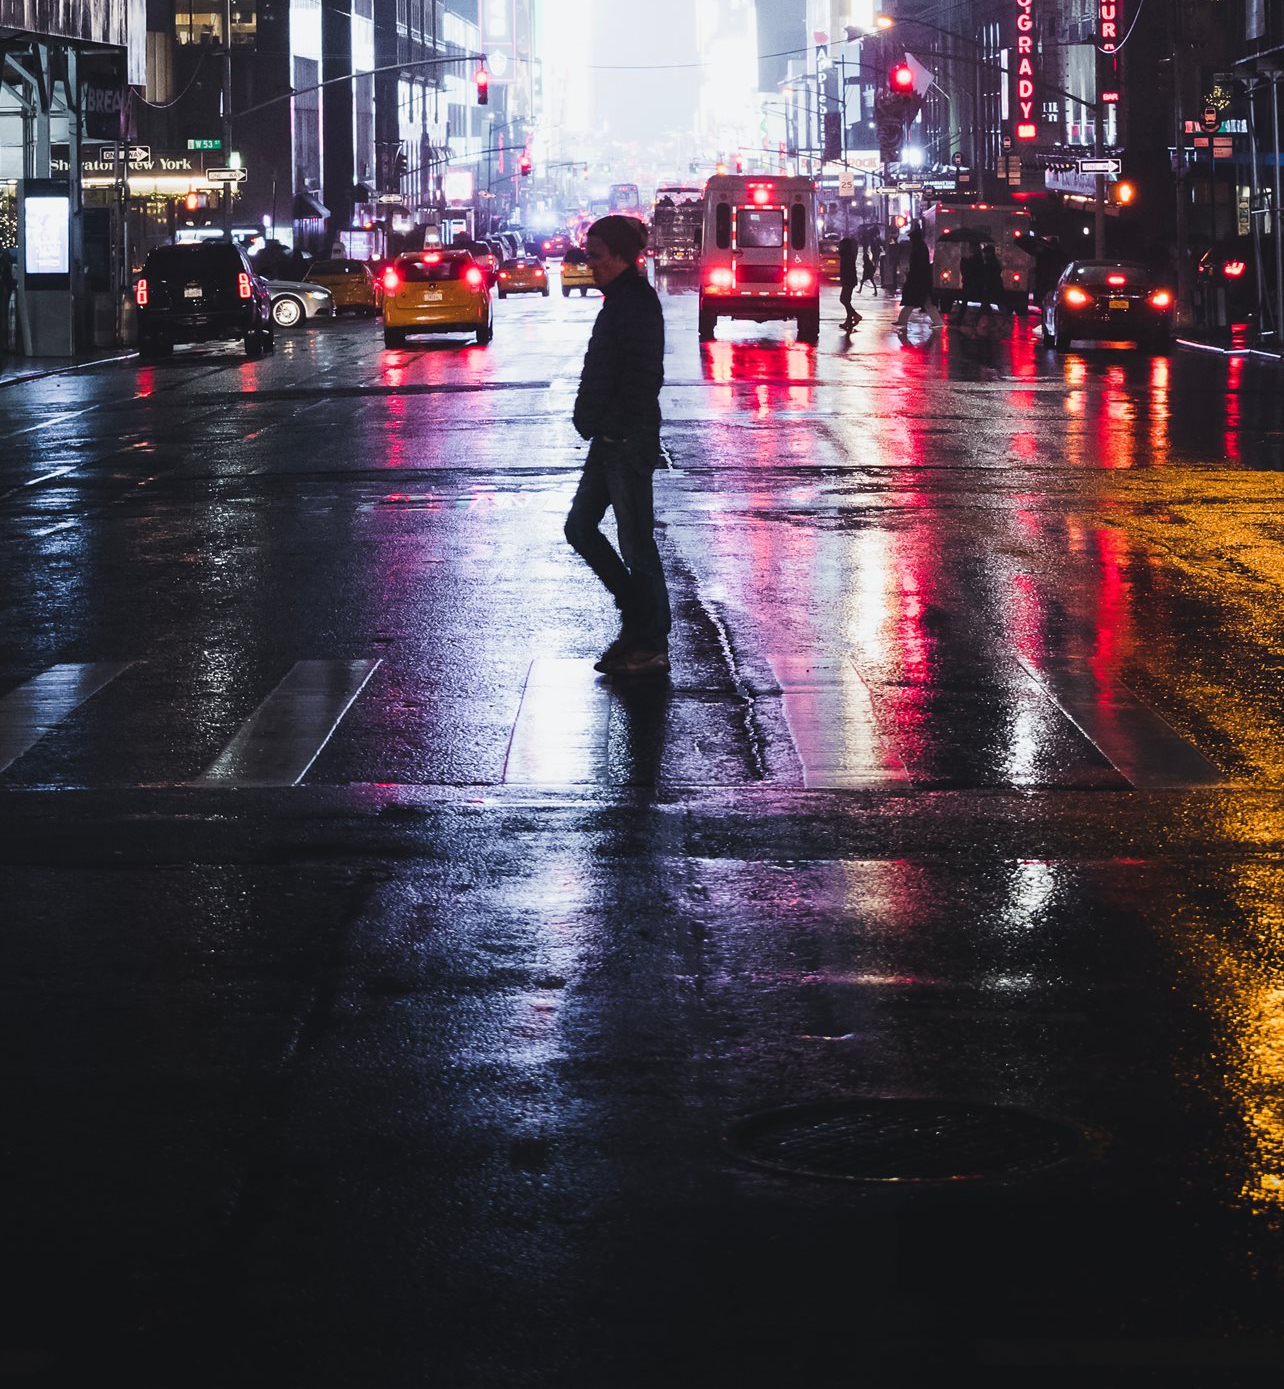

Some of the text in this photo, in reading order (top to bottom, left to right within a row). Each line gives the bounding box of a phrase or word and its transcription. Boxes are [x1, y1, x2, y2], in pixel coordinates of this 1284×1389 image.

[1102, 93, 1119, 101] BAR
[195, 140, 202, 149] W
[203, 140, 213, 149] 53
[160, 158, 192, 170] York
[841, 181, 853, 189] 25
